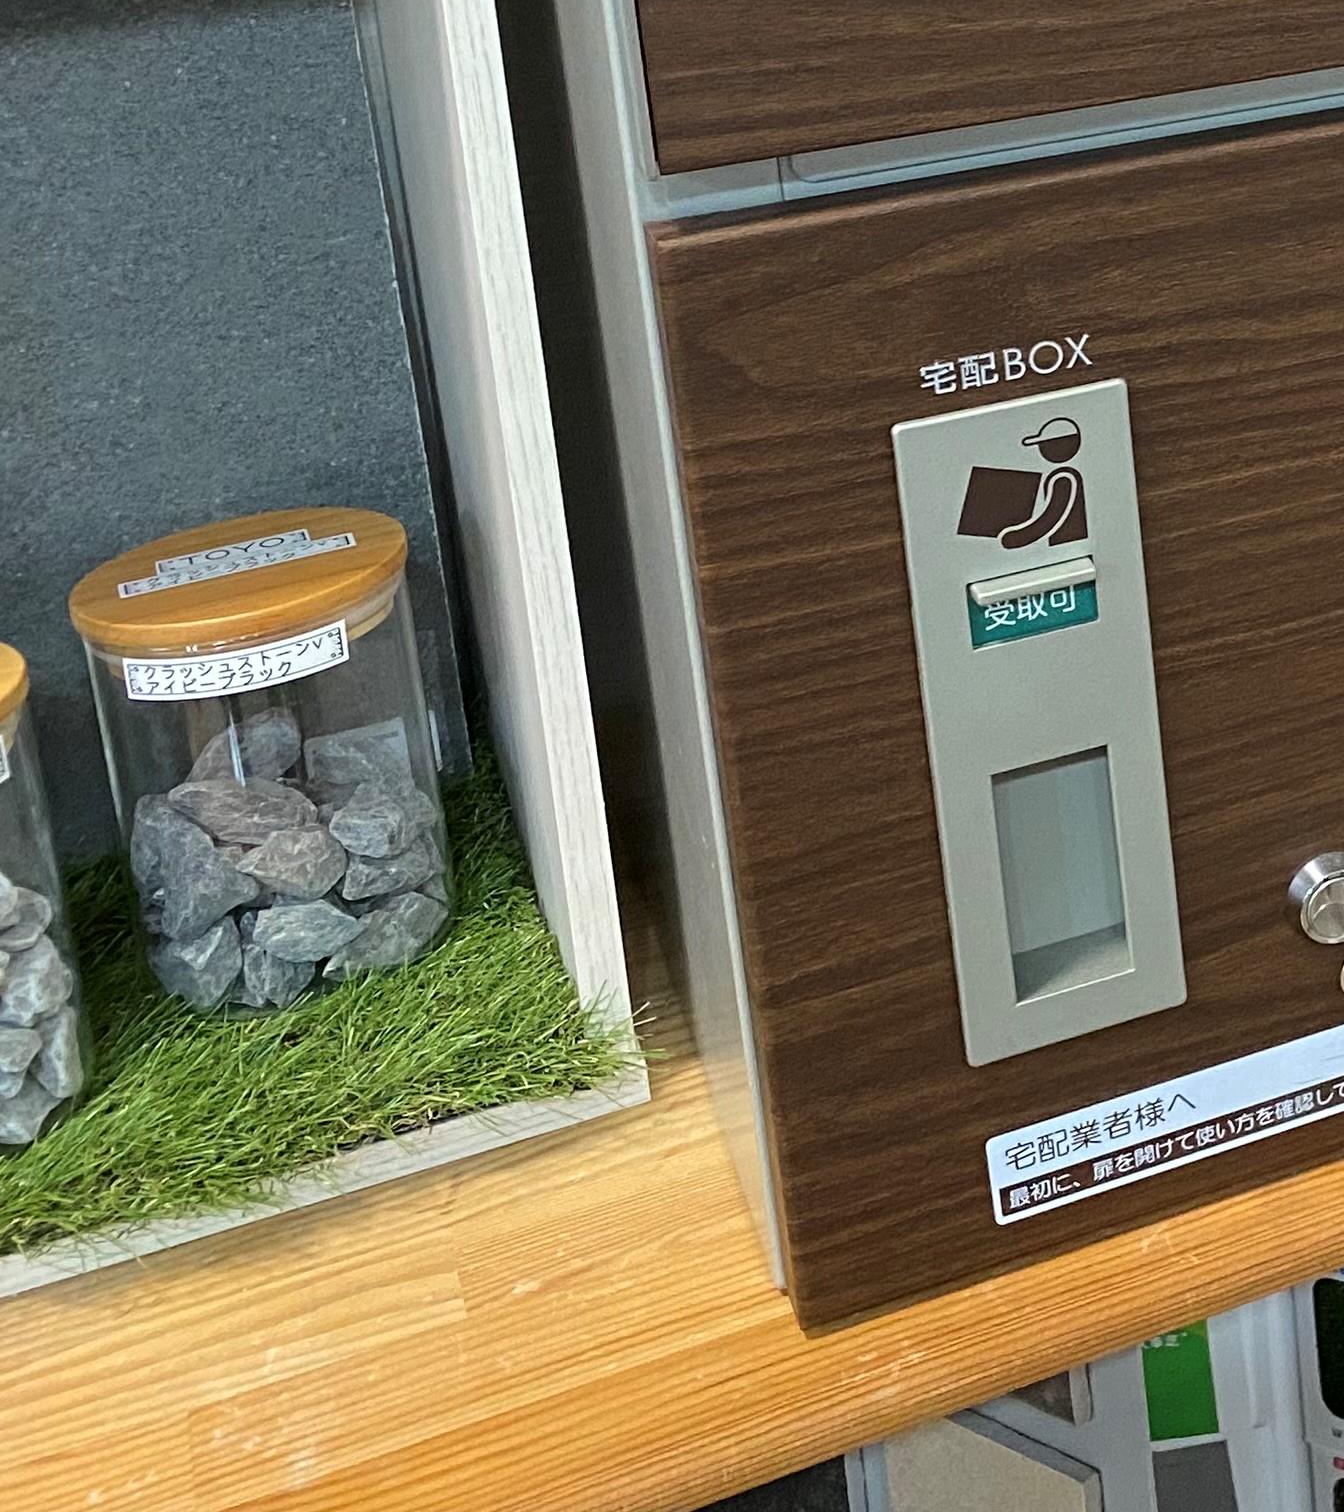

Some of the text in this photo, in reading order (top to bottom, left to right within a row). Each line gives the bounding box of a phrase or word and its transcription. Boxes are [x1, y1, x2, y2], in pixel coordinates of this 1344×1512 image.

[919, 334, 1093, 395] 宅配BOX
[184, 536, 286, 566] TOYO
[984, 585, 1076, 631] 受取可
[144, 637, 324, 680] クラッシュストーンV
[146, 661, 292, 694] アイビーブラック
[1003, 1093, 1197, 1172] 宅配業者様へ
